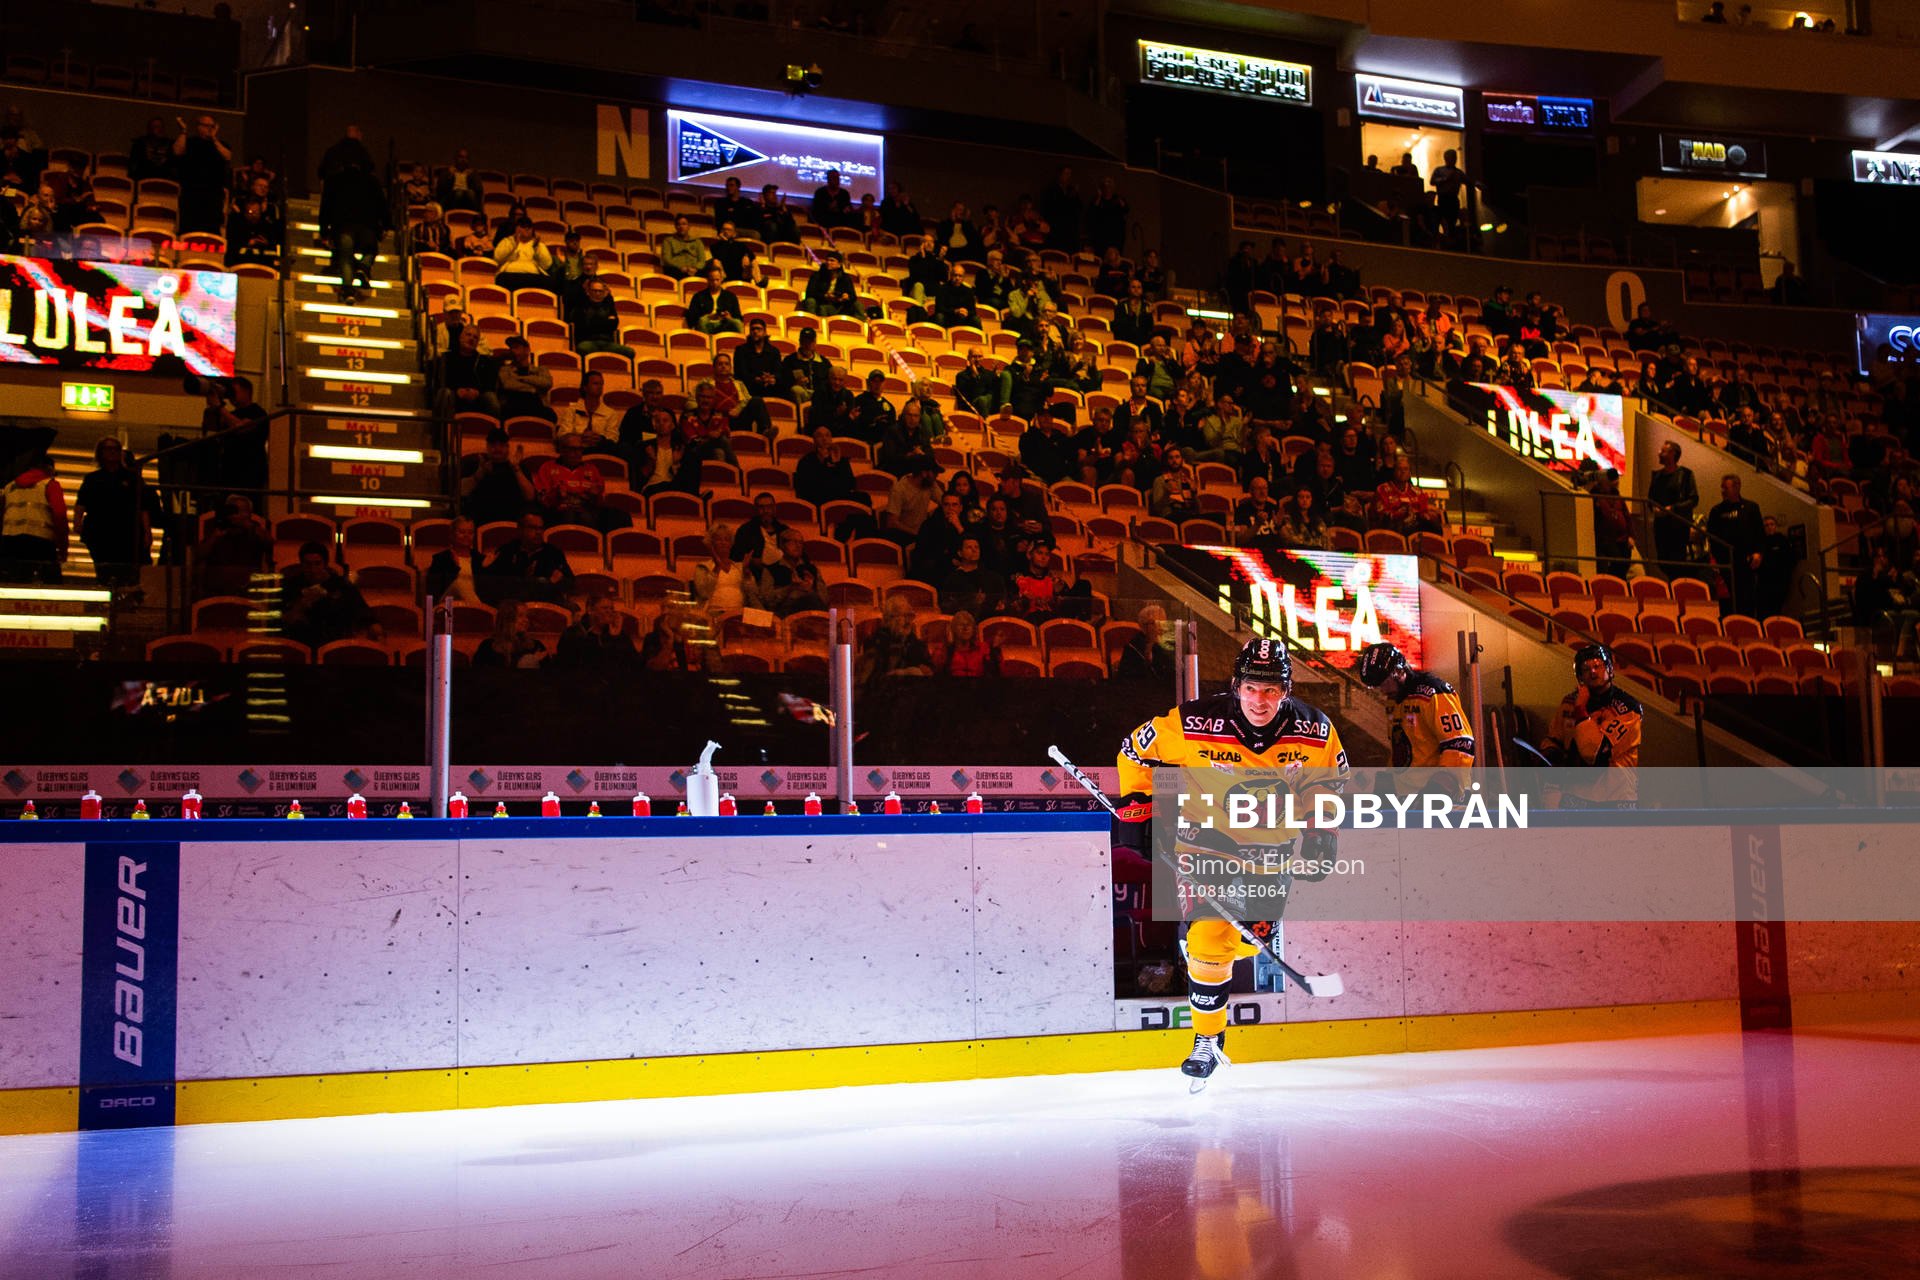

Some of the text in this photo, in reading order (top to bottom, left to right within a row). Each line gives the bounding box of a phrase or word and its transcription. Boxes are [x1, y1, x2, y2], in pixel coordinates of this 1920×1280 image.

[597, 104, 649, 179] N
[0, 276, 186, 357] LULEÅ
[342, 325, 359, 336] 14
[346, 358, 364, 370] 13
[351, 393, 369, 405] 12
[355, 433, 372, 445] 11
[361, 477, 380, 490] 10
[1184, 715, 1225, 733] SSAB
[1293, 719, 1328, 737] SSAB
[1440, 713, 1462, 733] 50
[1605, 718, 1628, 741] 24
[1210, 750, 1242, 763] LKAB
[1748, 834, 1773, 985] BAUER
[114, 855, 147, 1068] BAUER
[1190, 991, 1220, 1006] NEX
[1141, 1002, 1262, 1030] DAO
[100, 1096, 156, 1108] DACO
